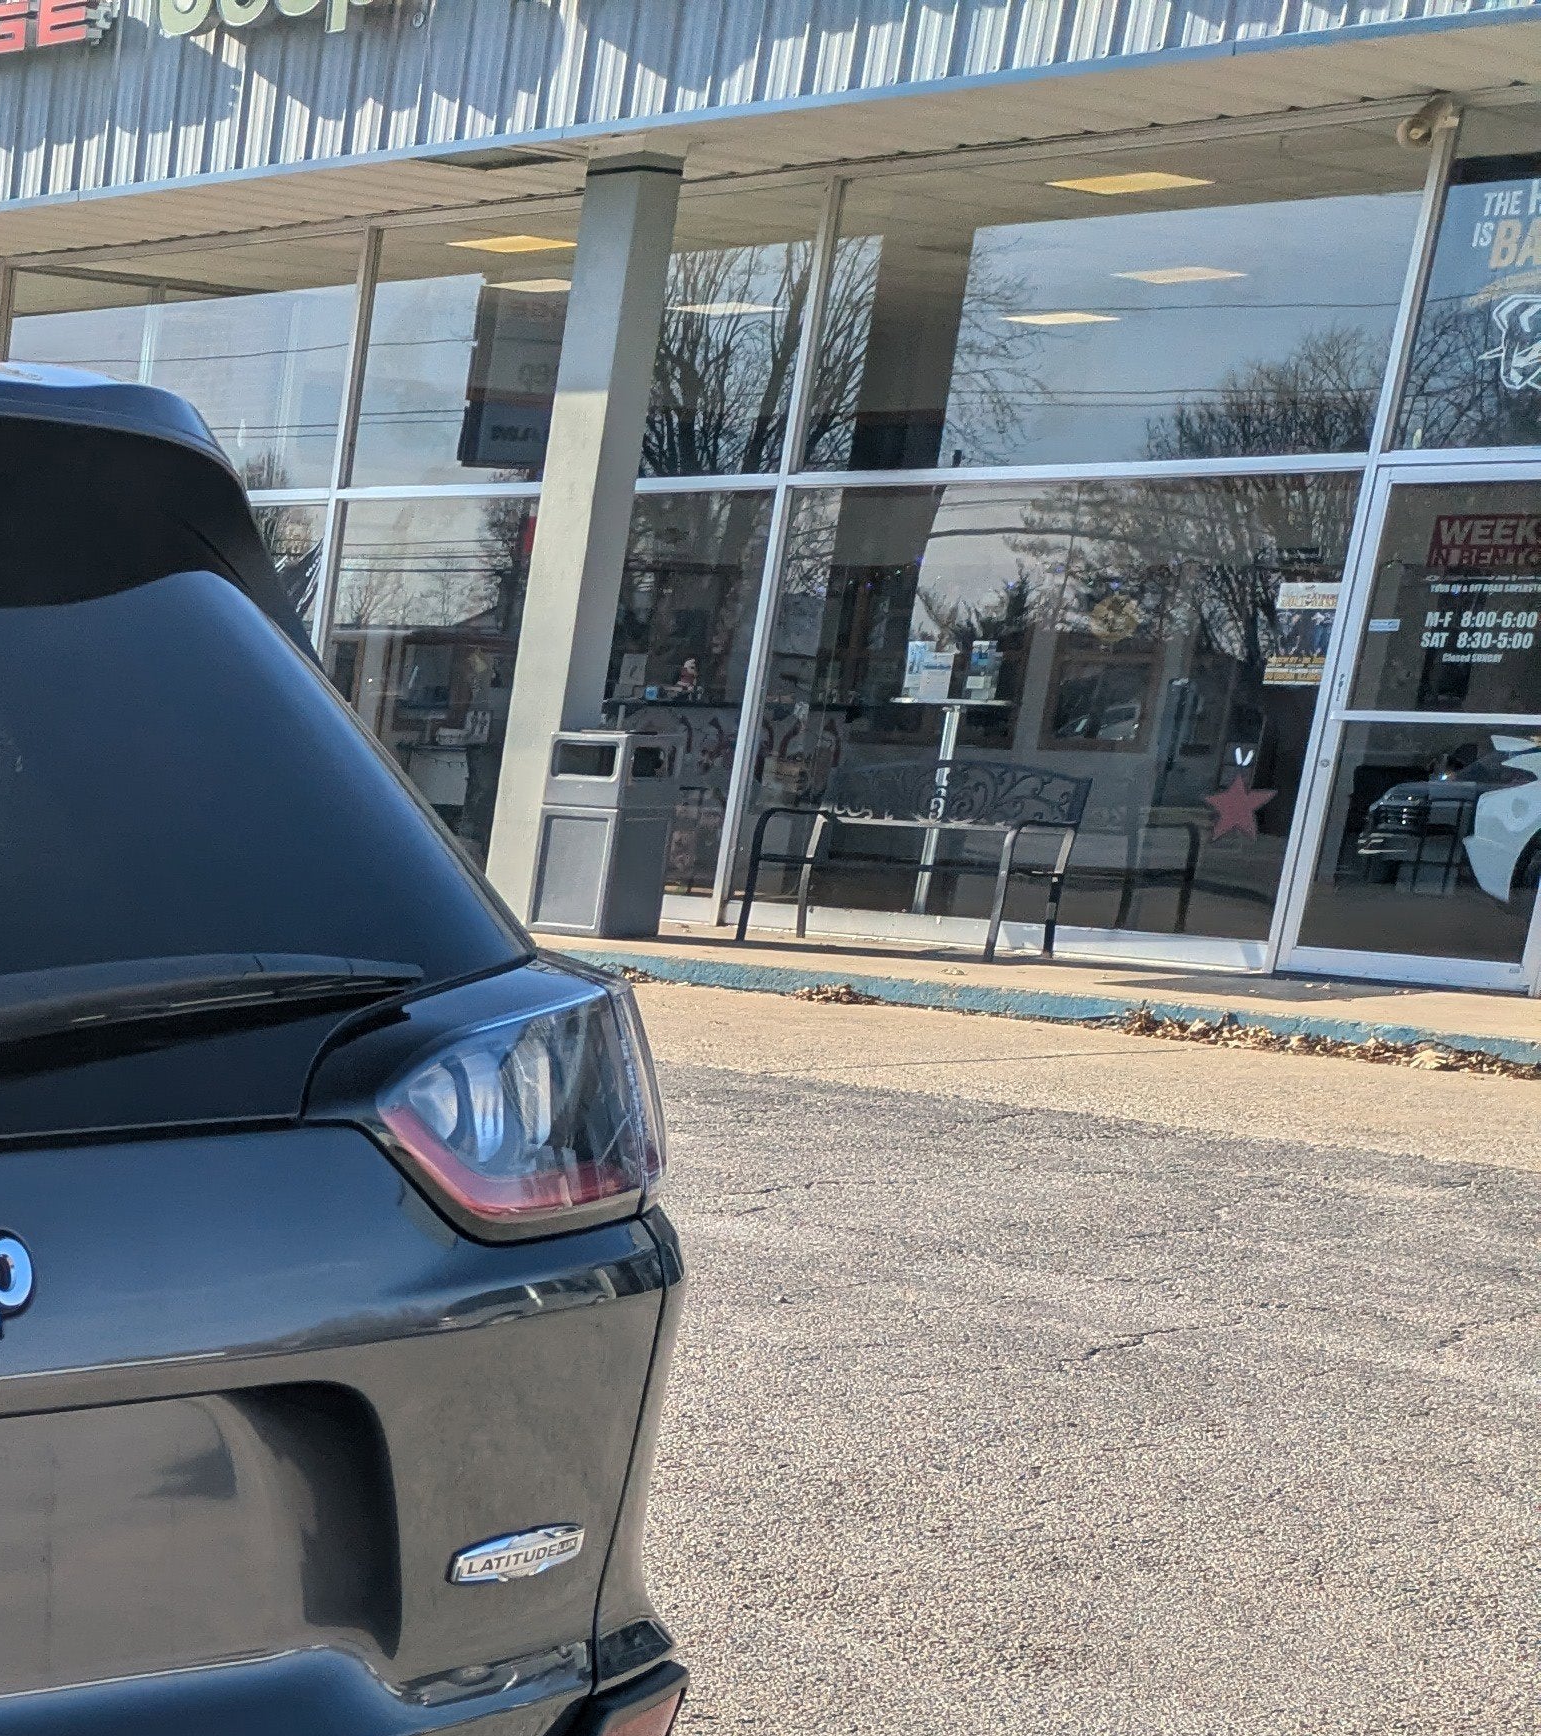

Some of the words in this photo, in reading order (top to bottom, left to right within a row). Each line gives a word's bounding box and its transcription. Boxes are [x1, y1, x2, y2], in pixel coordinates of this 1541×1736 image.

[1483, 190, 1523, 217] THE
[1471, 222, 1494, 247] IS
[1425, 611, 1454, 628] M-F
[1460, 611, 1539, 629] 8:00-6:00
[1420, 632, 1450, 648] SAT
[1456, 632, 1535, 649] 8:30-5:00
[466, 1544, 557, 1575] LATITUDE
